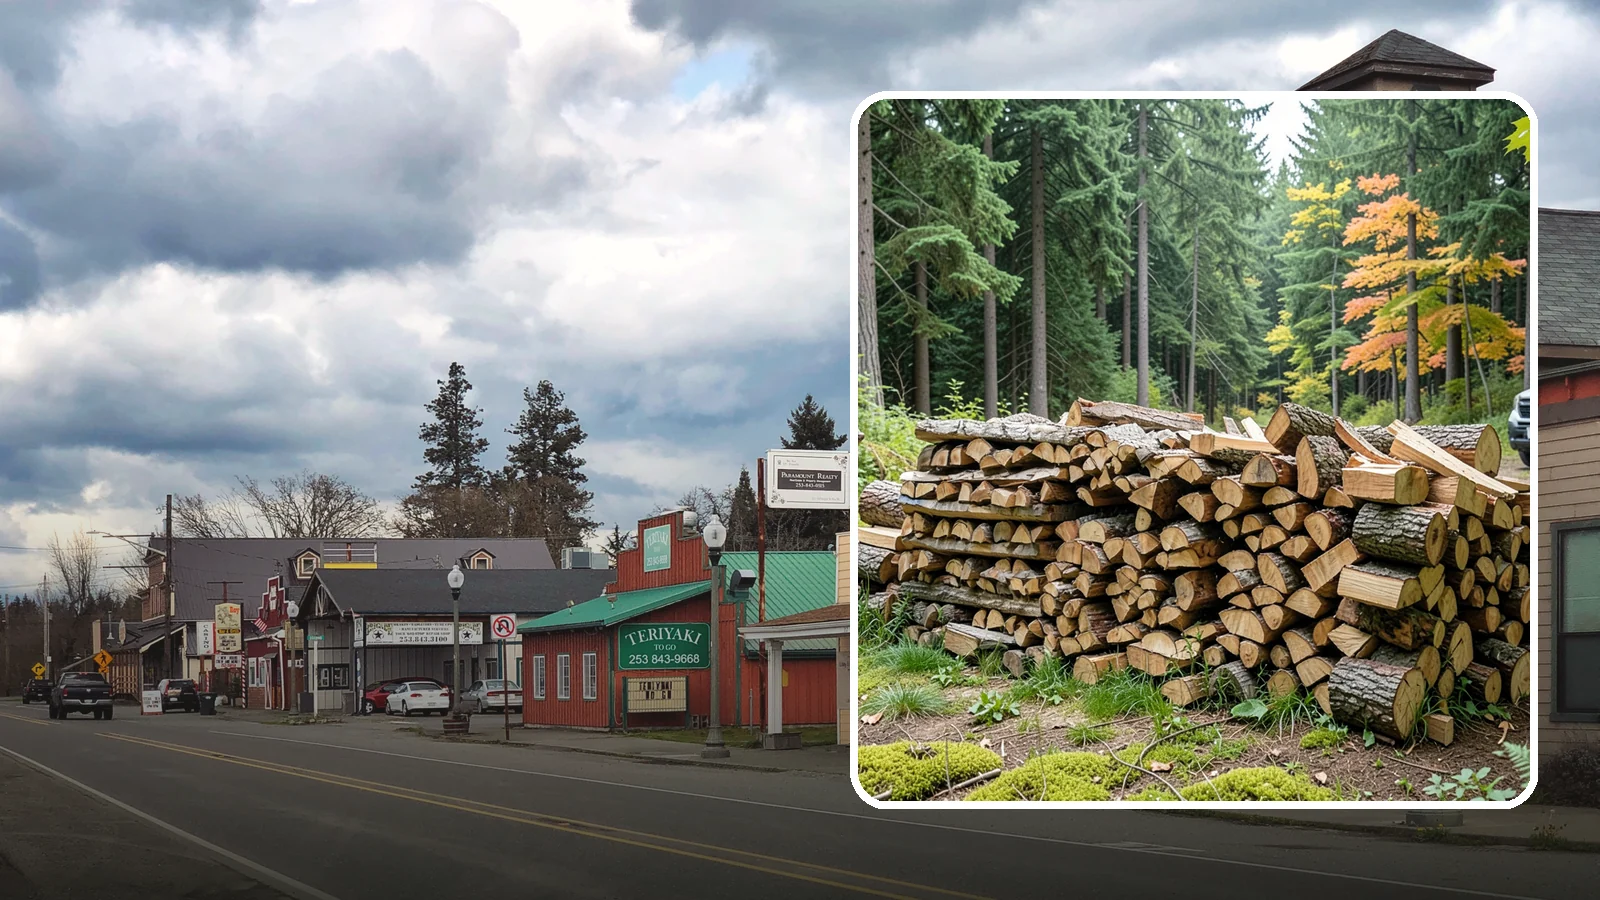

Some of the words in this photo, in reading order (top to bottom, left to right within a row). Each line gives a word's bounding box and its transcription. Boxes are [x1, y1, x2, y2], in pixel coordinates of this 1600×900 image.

[625, 627, 702, 646] TERIYAKI
[629, 655, 648, 664] 253
[652, 654, 700, 664] 843-9668
[639, 681, 672, 690] TERIYAKI
